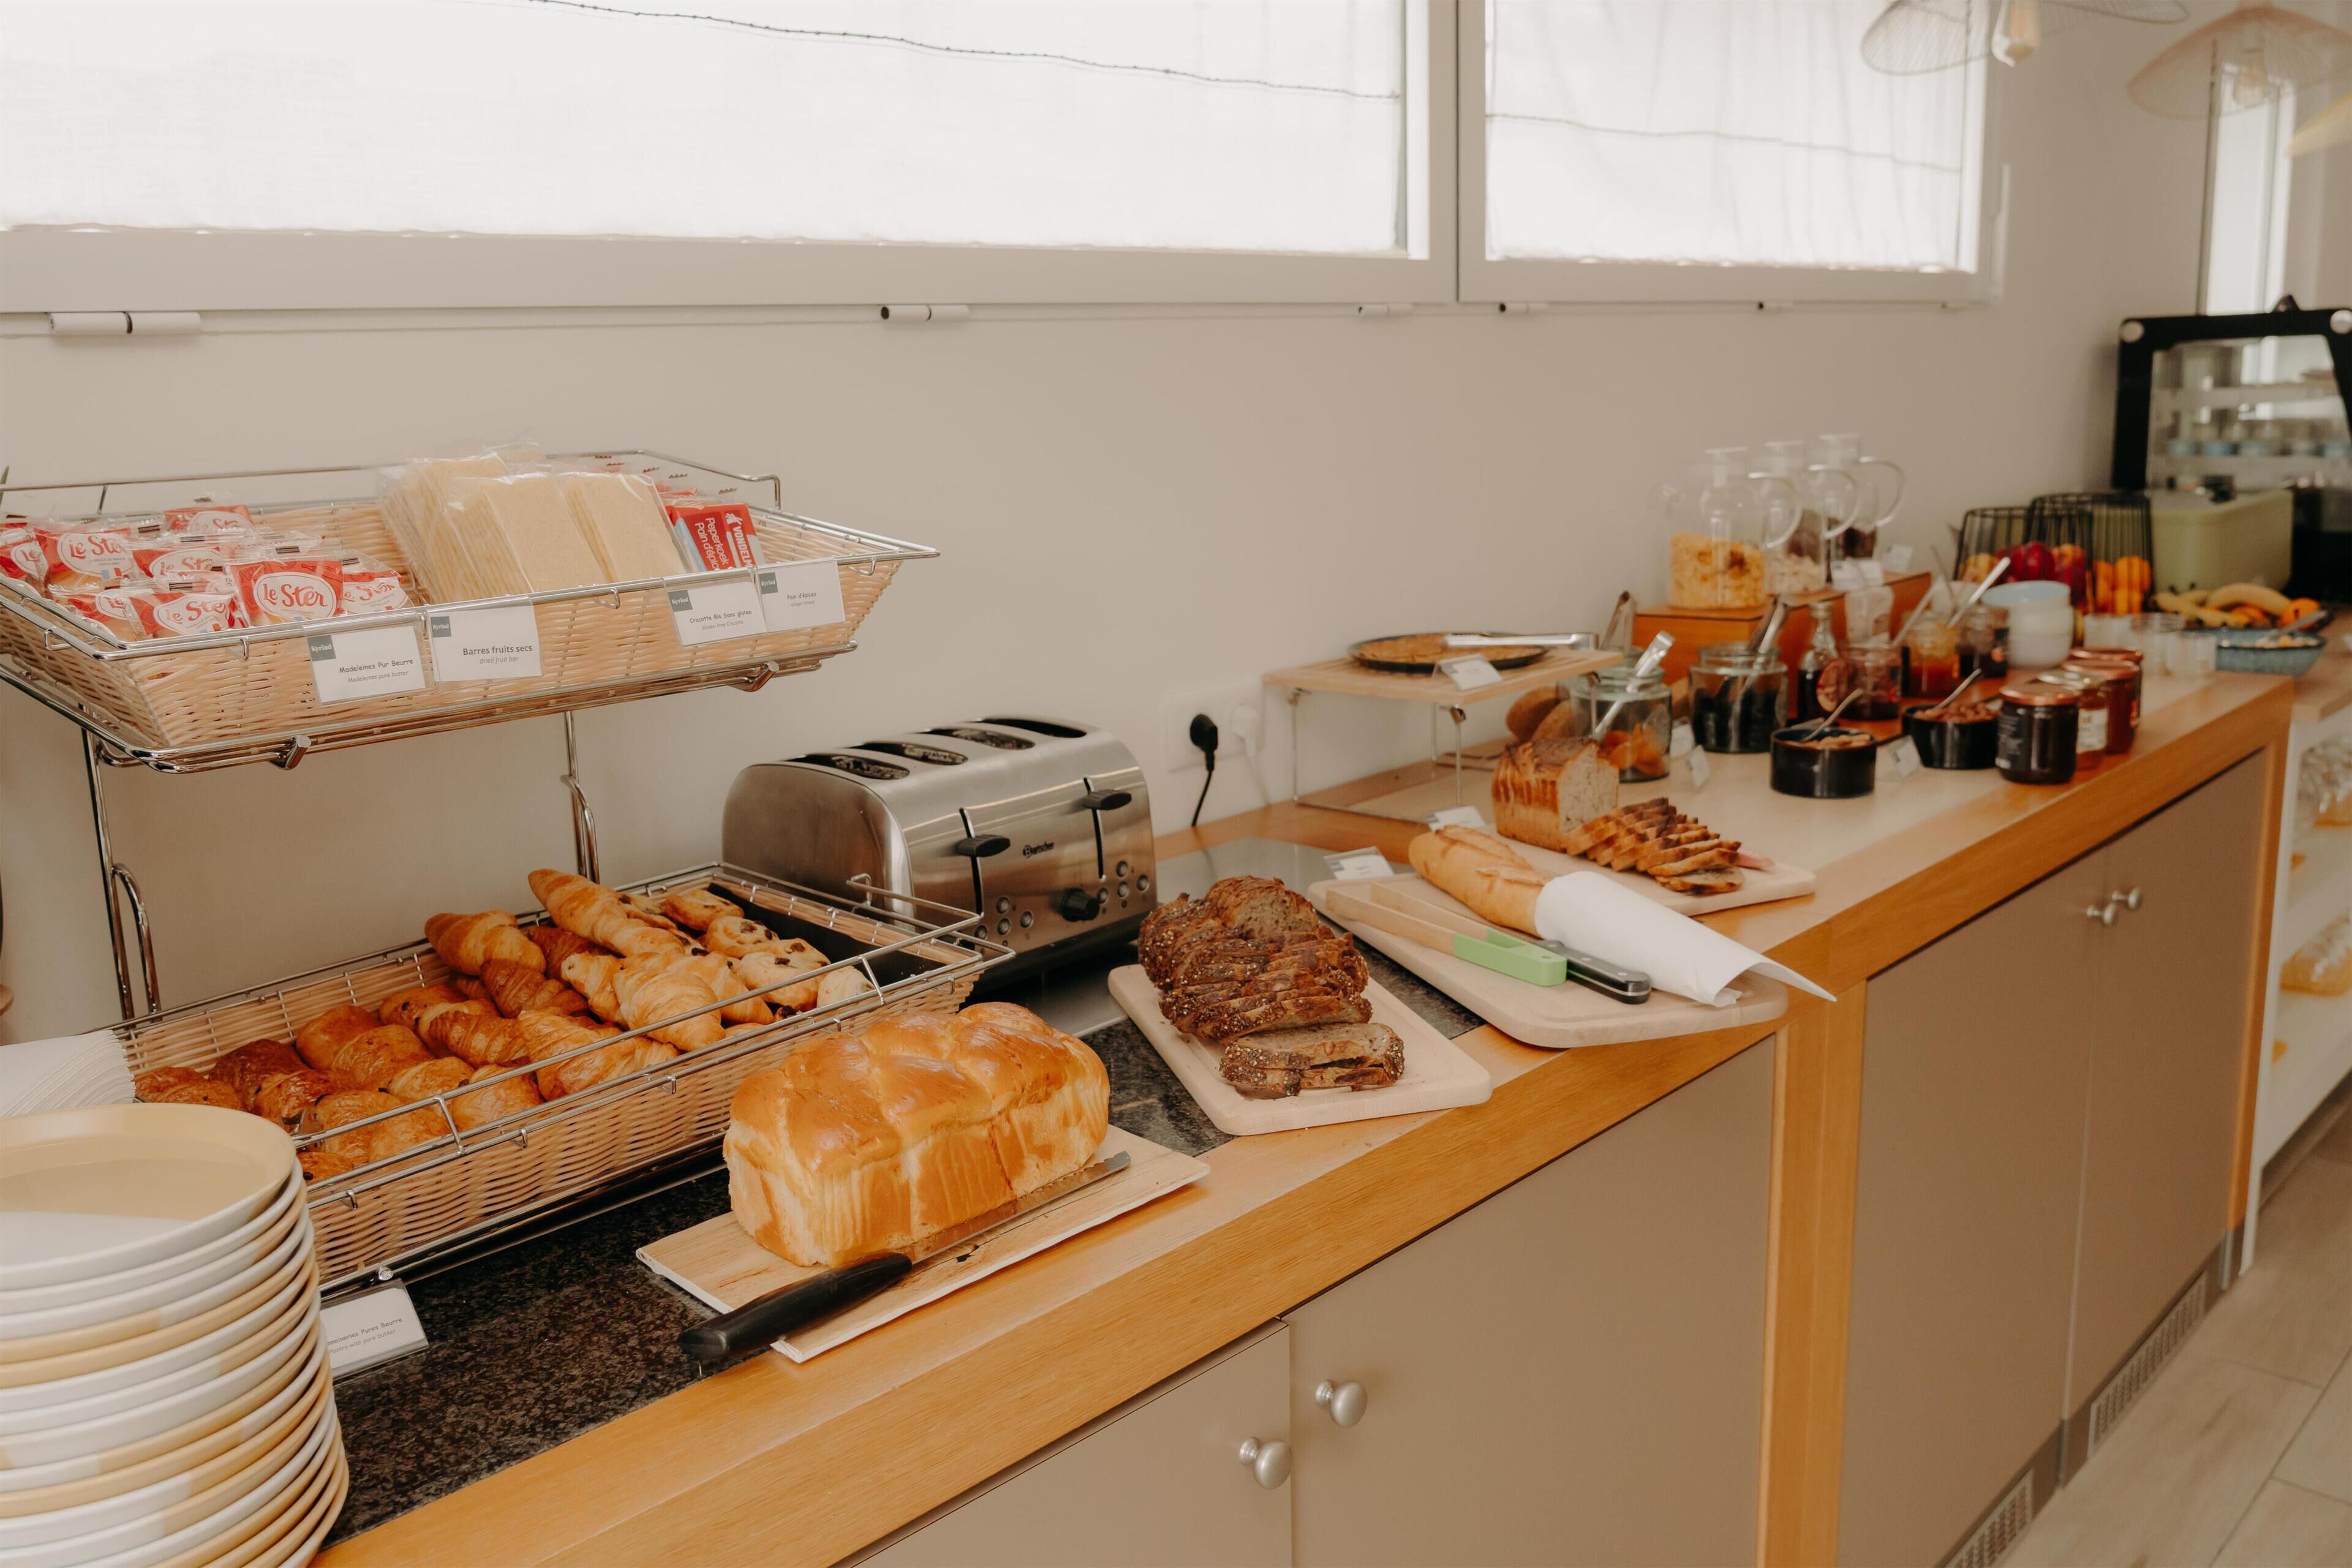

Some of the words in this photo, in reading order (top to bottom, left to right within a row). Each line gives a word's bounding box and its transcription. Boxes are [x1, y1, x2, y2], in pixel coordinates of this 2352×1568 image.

[69, 539, 86, 559] Le
[695, 522, 707, 542] Pain
[704, 543, 720, 570] d'épic
[706, 518, 729, 565] Peperkoek
[733, 526, 753, 567] VONDELM
[263, 584, 277, 605] Le
[281, 583, 328, 607] Ster
[165, 609, 183, 625] Le
[186, 600, 227, 621] Ste
[690, 615, 712, 624] Cracotte
[311, 644, 332, 653] Kyriad
[463, 647, 490, 655] Barres
[339, 664, 376, 673] Madeleines
[495, 656, 508, 665] fruit
[348, 674, 378, 683] Madeleines
[1022, 841, 1054, 859] Bartscher
[327, 1332, 359, 1346] nnoiseries
[361, 1325, 379, 1334] Pures
[380, 1317, 402, 1328] Beurre
[329, 1344, 349, 1354] Pastry
[363, 1336, 376, 1344] pure
[377, 1329, 396, 1339] butter
